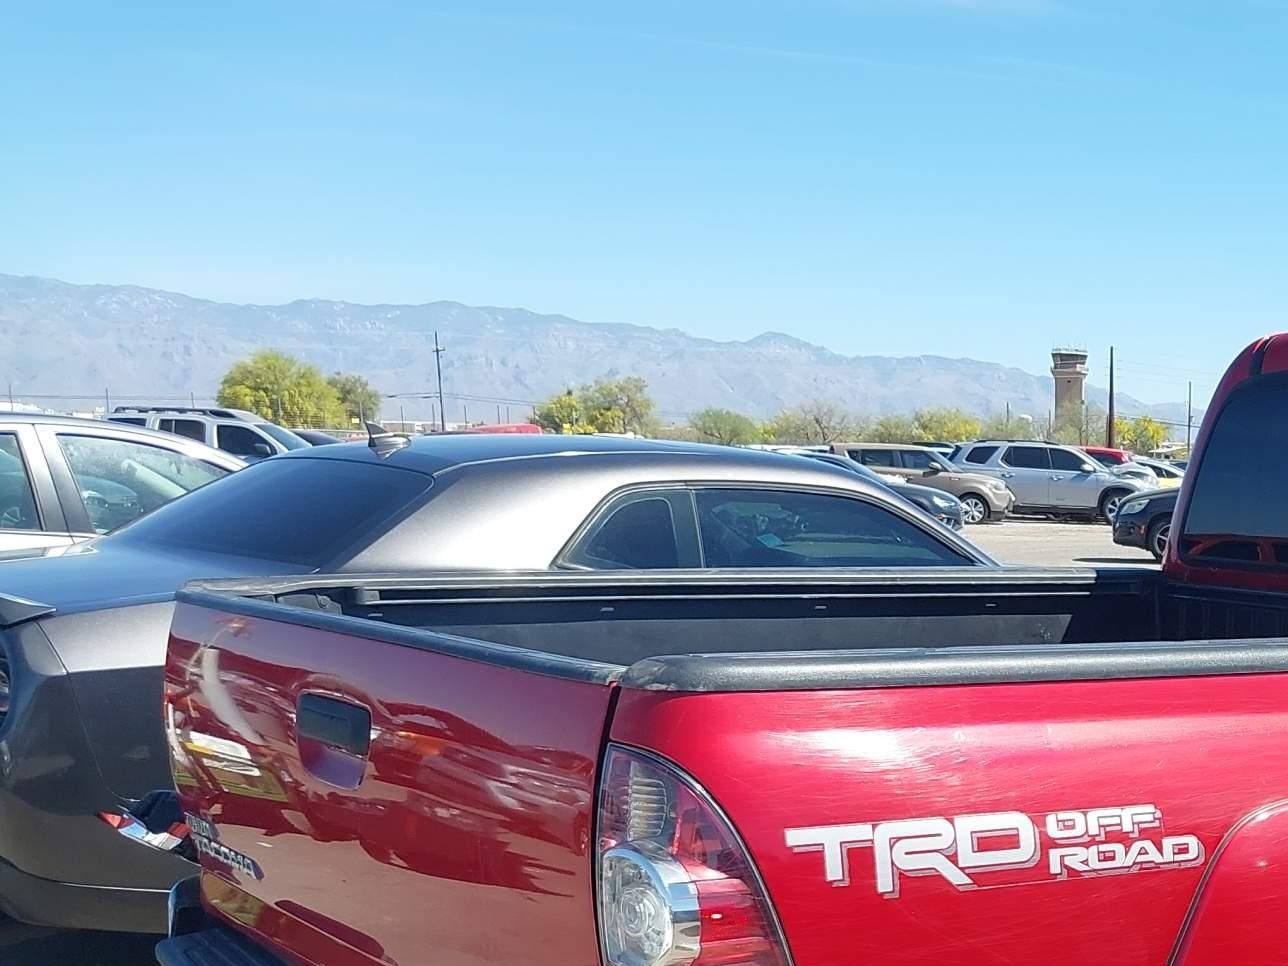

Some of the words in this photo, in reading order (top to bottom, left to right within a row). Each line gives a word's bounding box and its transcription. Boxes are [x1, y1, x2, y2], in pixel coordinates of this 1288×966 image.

[1045, 804, 1162, 842] OFF
[784, 810, 1041, 898] TRD
[1047, 835, 1206, 879] ROAD
